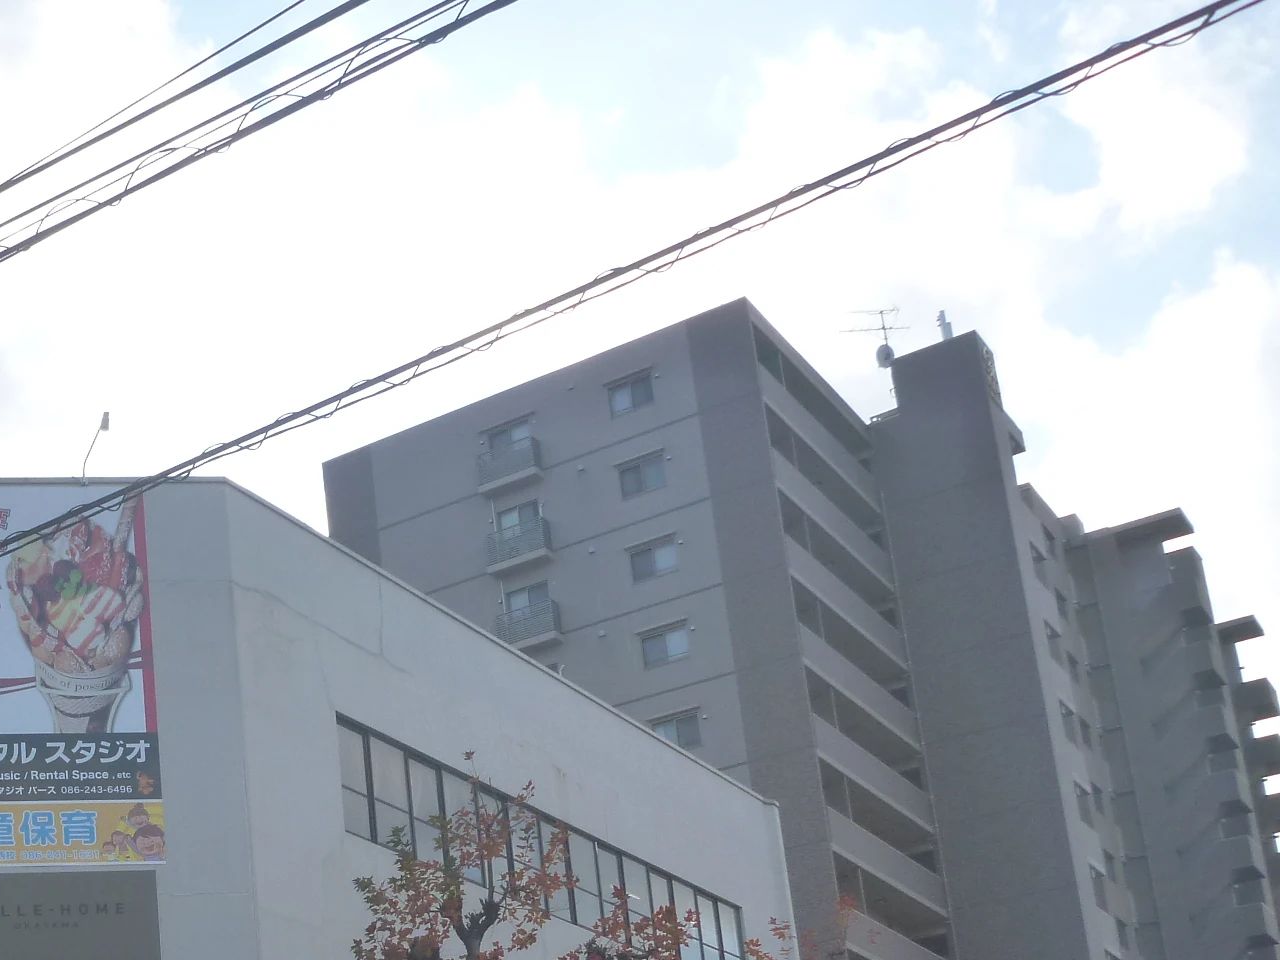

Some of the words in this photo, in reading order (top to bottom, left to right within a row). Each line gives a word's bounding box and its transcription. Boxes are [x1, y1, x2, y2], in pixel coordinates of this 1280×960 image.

[30, 770, 69, 780] Rental
[71, 769, 109, 781] Space
[60, 785, 133, 795] 086-243-6496
